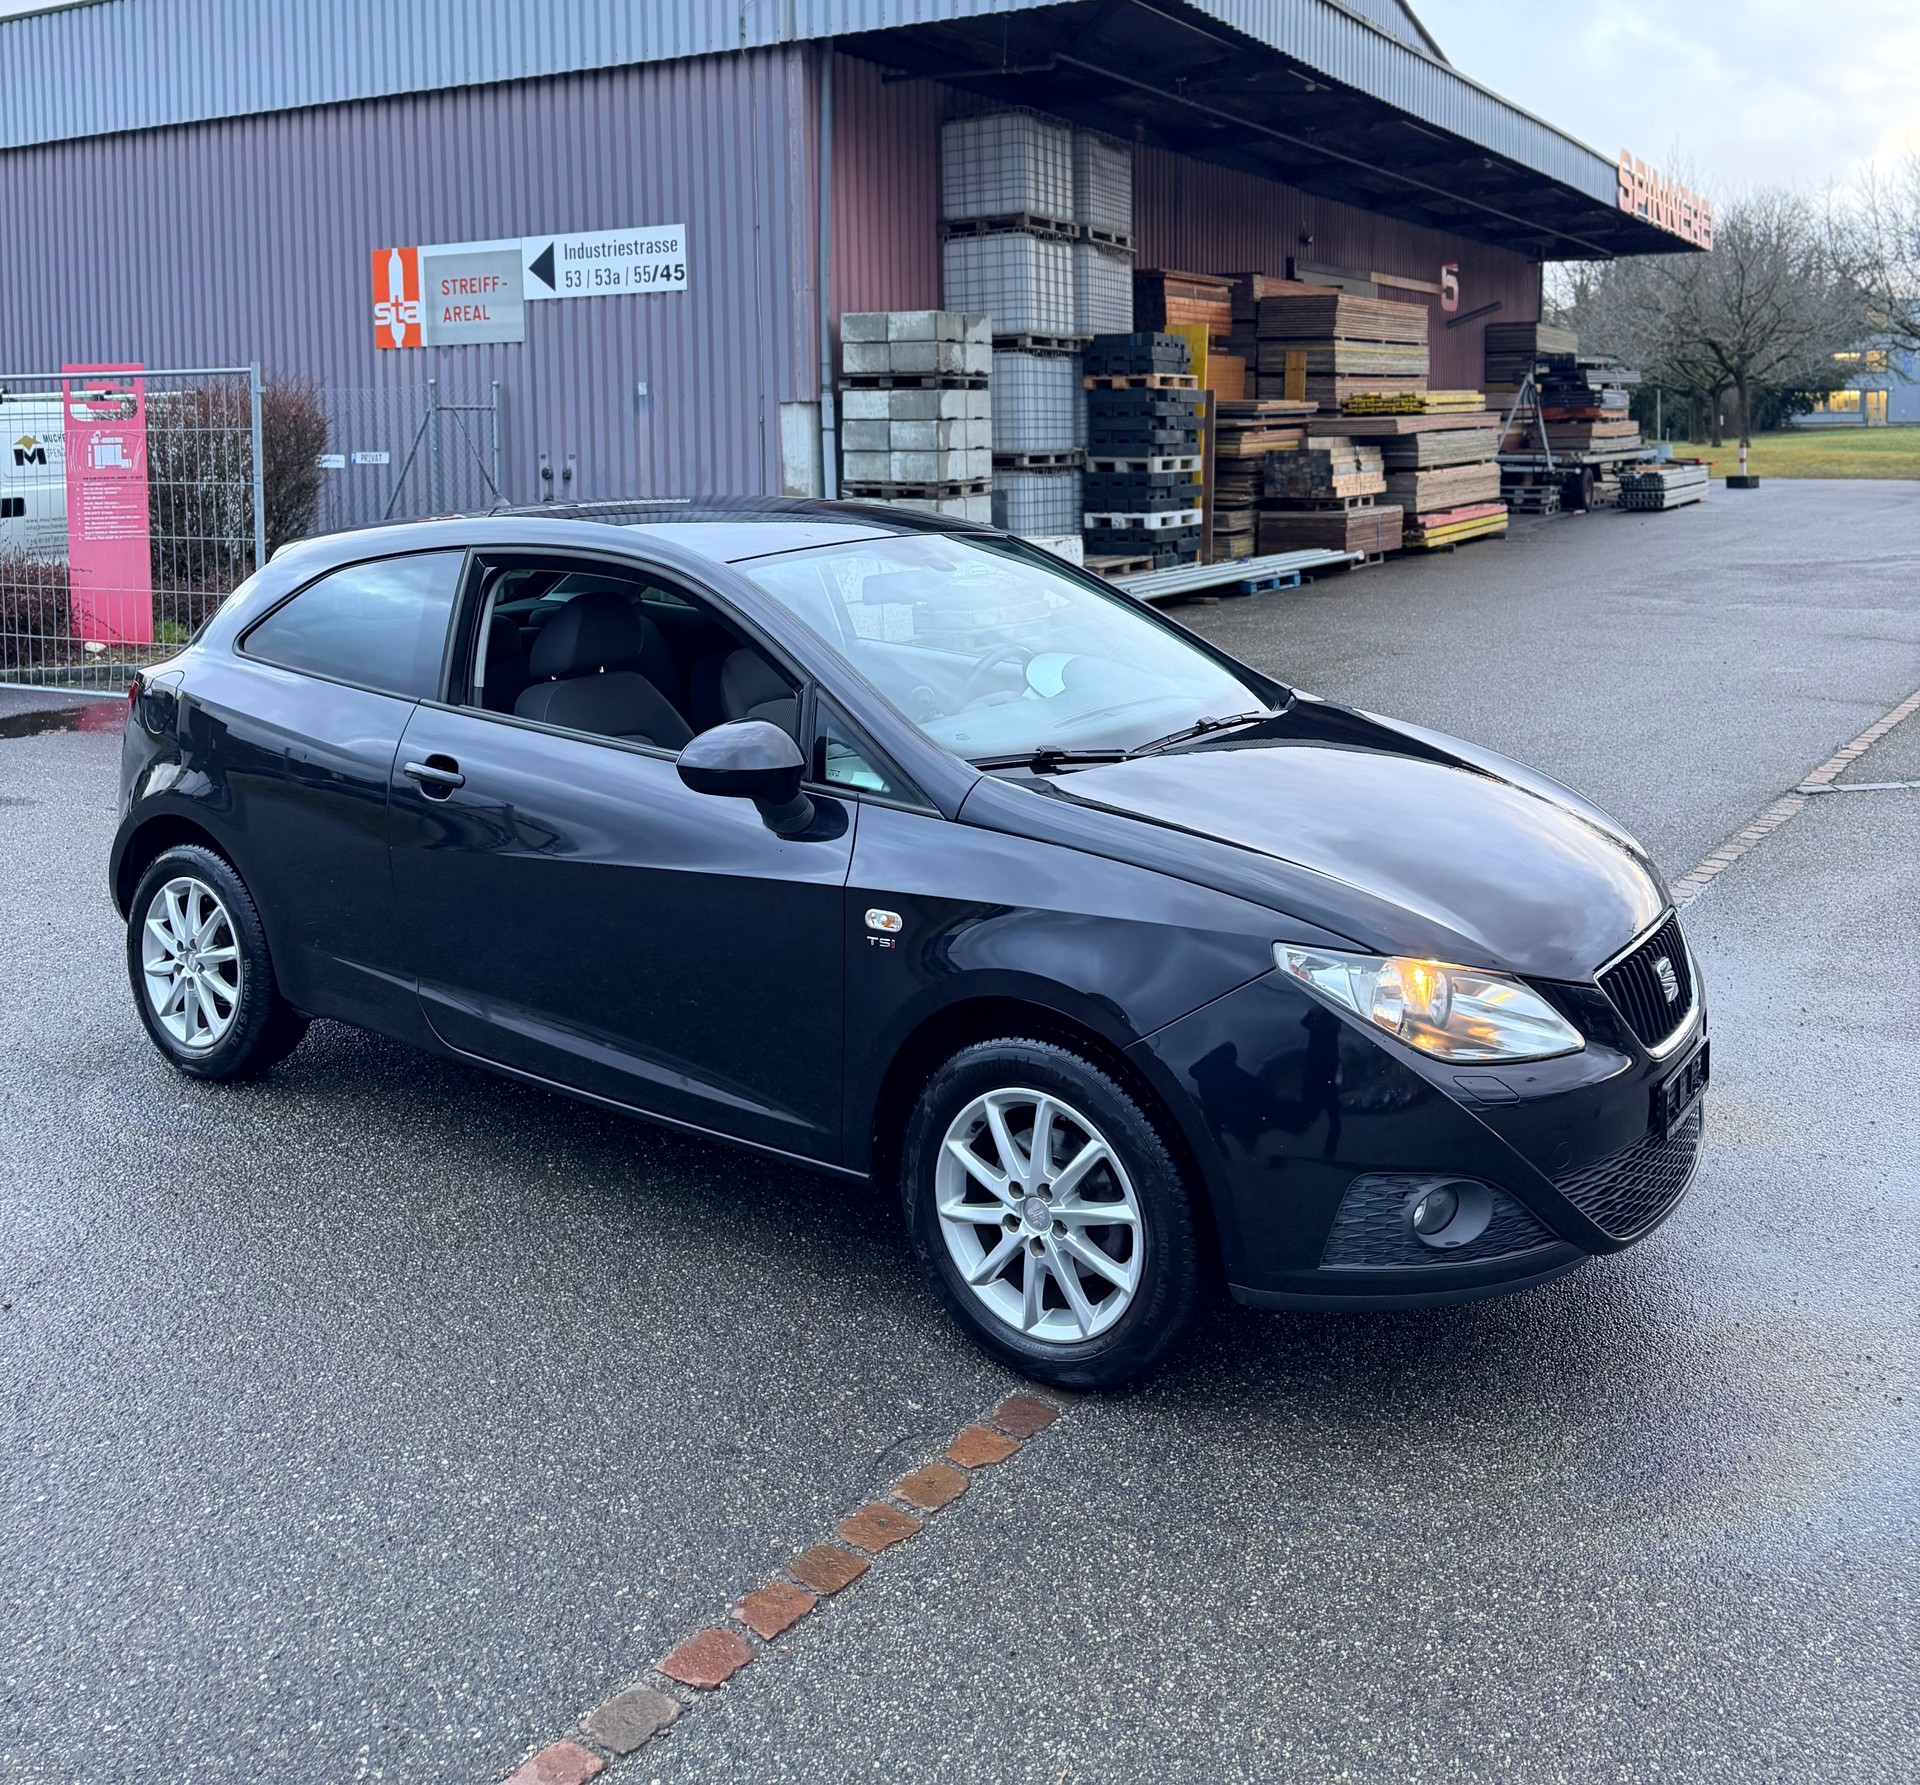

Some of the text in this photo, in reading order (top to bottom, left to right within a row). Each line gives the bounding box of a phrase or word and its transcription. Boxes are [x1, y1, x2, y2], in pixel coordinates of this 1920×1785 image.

[564, 237, 678, 260] Industriestrasse
[441, 275, 508, 296] STREIFF-
[565, 269, 582, 288] 53
[595, 266, 621, 286] 53a
[633, 263, 686, 283] 55/45
[1441, 258, 1459, 312] 5
[374, 294, 420, 326] sta
[443, 304, 491, 323] AREAL
[361, 453, 382, 463] PRIVAT
